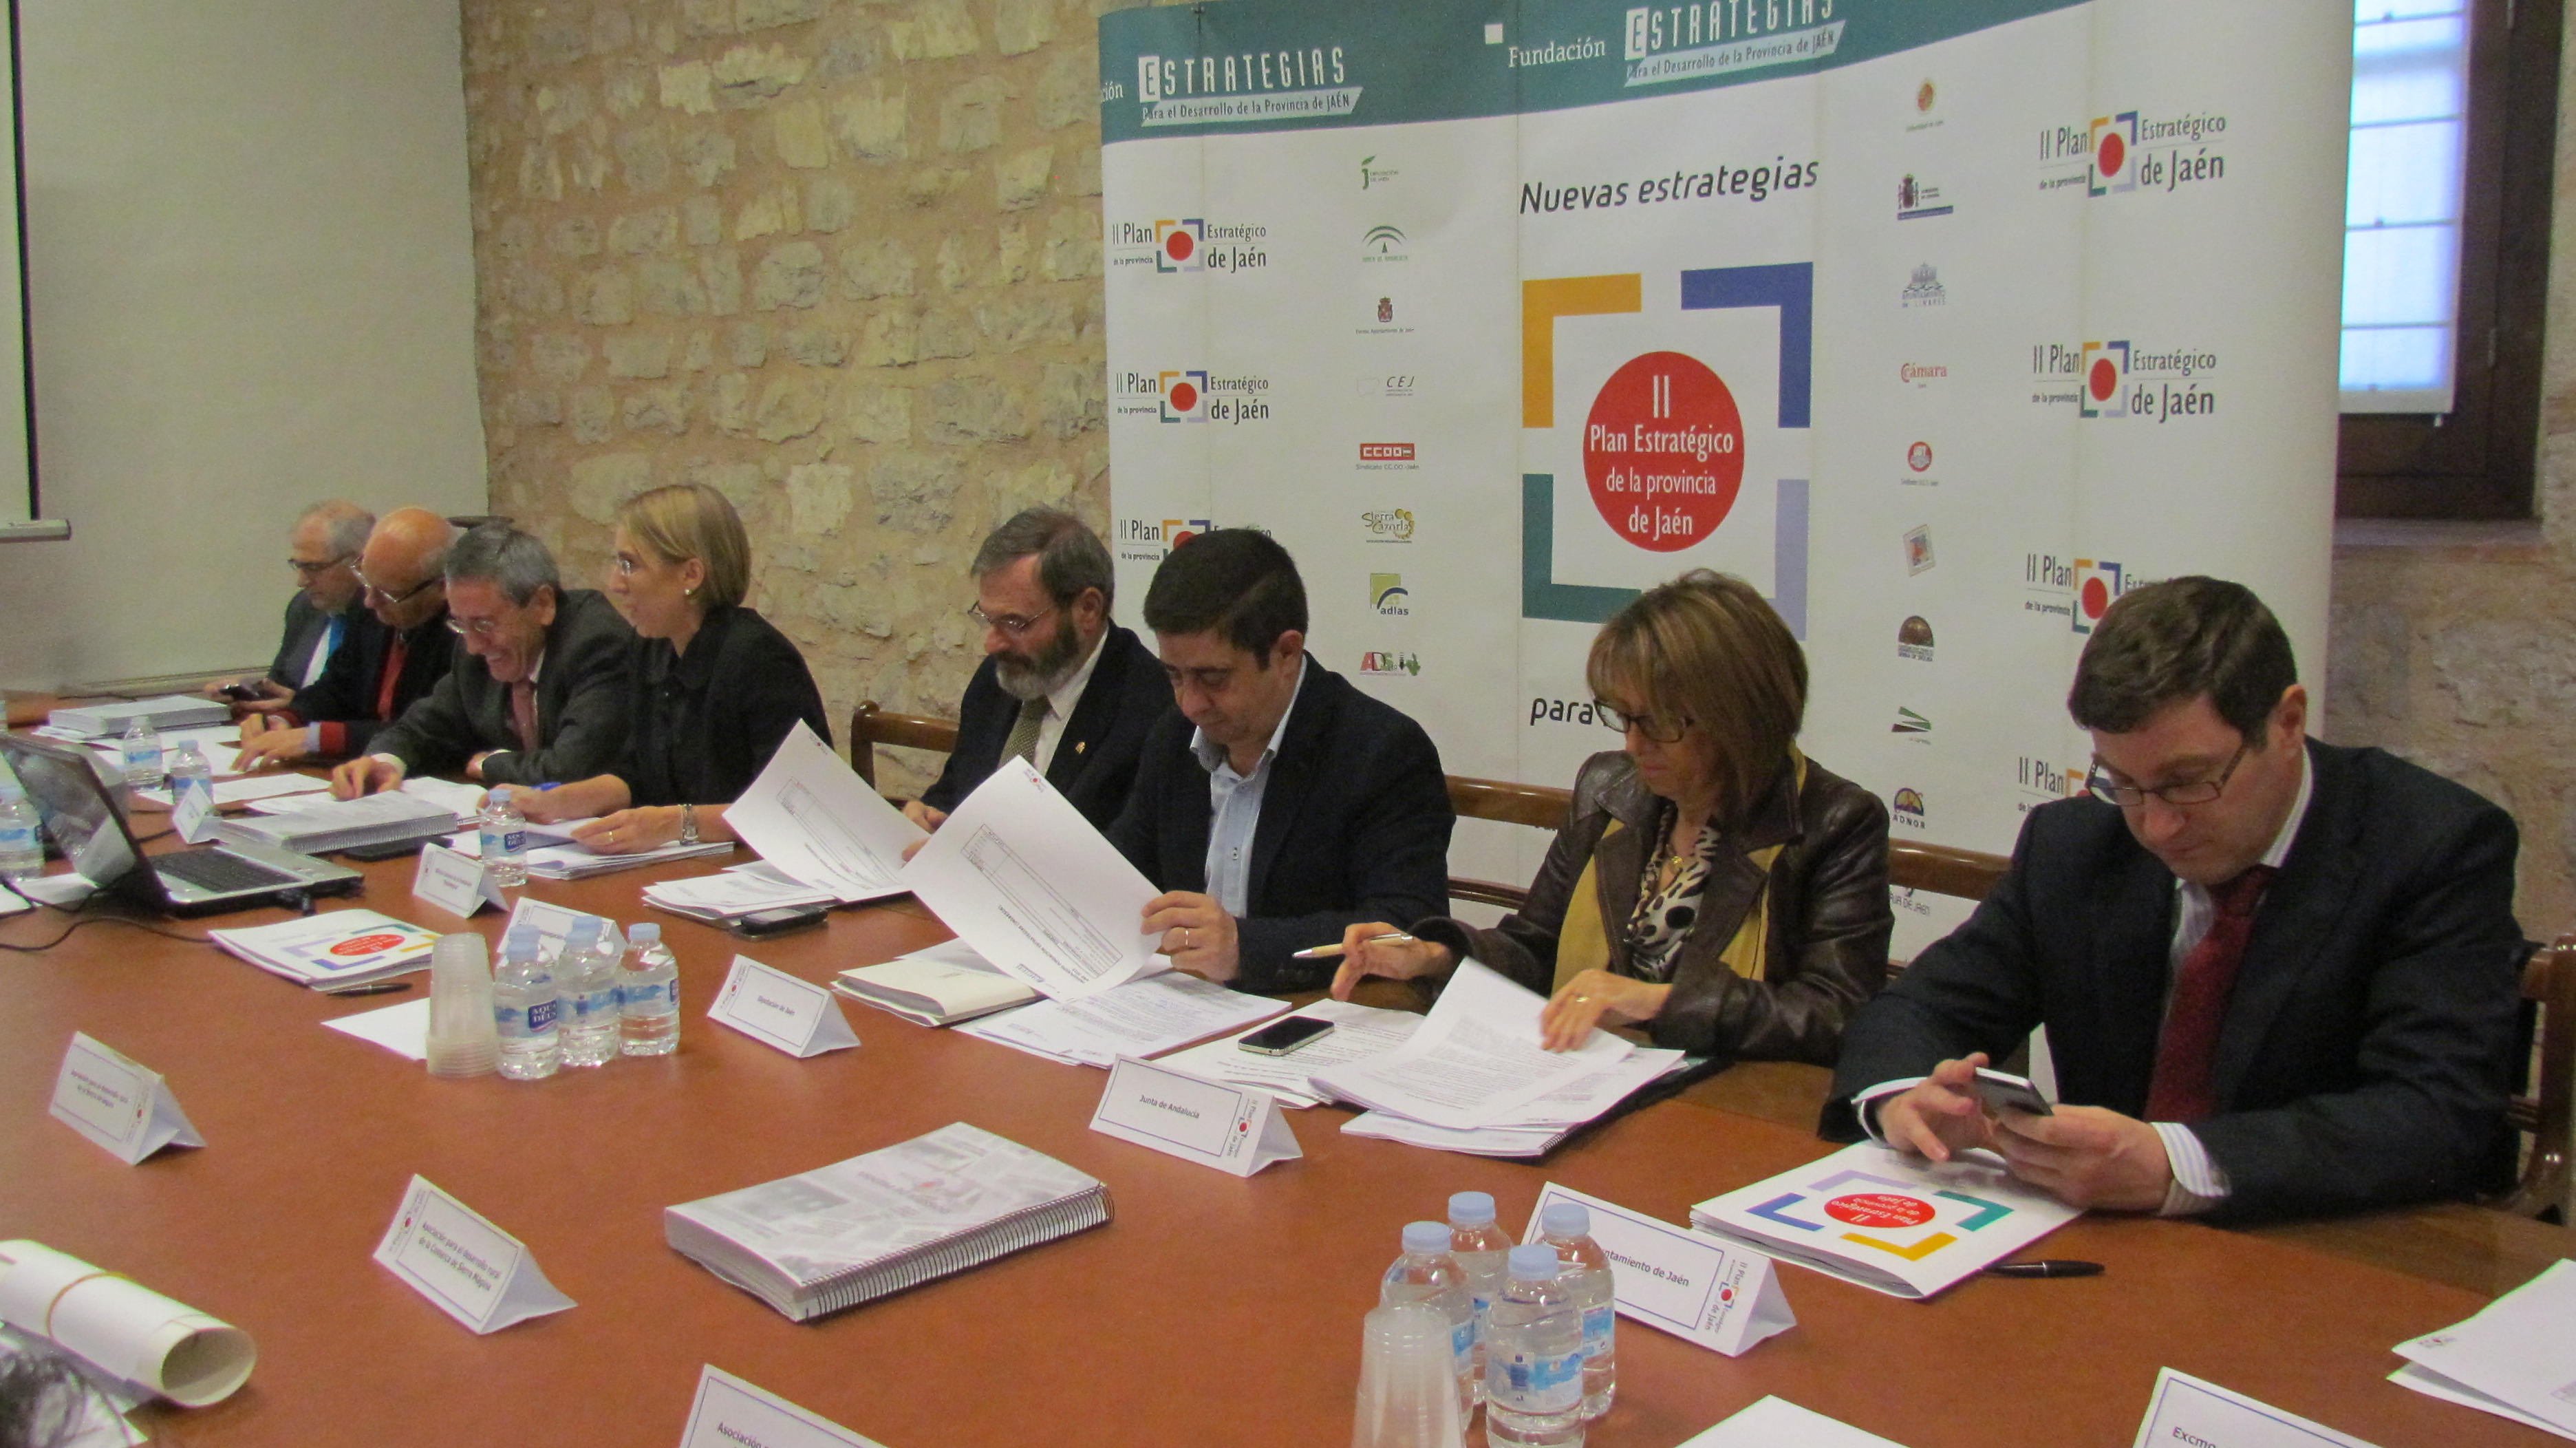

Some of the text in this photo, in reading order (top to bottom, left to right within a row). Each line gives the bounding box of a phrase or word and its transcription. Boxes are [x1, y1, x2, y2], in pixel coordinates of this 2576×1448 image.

[1508, 36, 1605, 67] Fundación
[1627, 63, 1648, 78] Para
[1652, 63, 1660, 76] el
[1664, 54, 1715, 74] Desarrollo
[1719, 52, 1729, 66] de
[1733, 48, 1742, 63] la
[1746, 42, 1792, 61] Provincia
[1796, 39, 1809, 52] de
[1139, 47, 1345, 102] ESTRATEGIAS
[1143, 92, 1350, 120] Para el Desarrollo de la Provincia de JAÉN
[2040, 112, 2226, 160] II Plan Estratégico
[2141, 147, 2225, 193] de Jaén
[1520, 156, 1819, 215] Nuevas estrategias
[1113, 224, 1266, 244] II Plan Estratégico
[1208, 246, 1266, 273] de Jaén
[1900, 363, 1947, 383] Cámara
[2033, 344, 2217, 376] II Plan Estratégico
[1116, 372, 1269, 394] II Plan Estratégico
[1653, 375, 1670, 418] II
[1212, 398, 1269, 425] de Jaén
[2132, 384, 2214, 423] de Jaén
[1590, 425, 1733, 462] Plan Estratégico
[1607, 467, 1716, 500] de la provincia
[1132, 520, 1159, 540] Plan
[1362, 511, 1394, 527] Sierra
[1373, 520, 1408, 534] Cazorla
[1629, 506, 1693, 541] de Jaén
[2043, 555, 2072, 587] Plan
[1381, 606, 1409, 615] adlas
[1530, 698, 1593, 726] para
[2035, 760, 2064, 795] Plan
[1893, 814, 1925, 829] ADNOR
[1139, 1094, 1200, 1119] Junta de Andalucía
[1893, 1215, 1918, 1224] Plan
[1653, 1267, 1665, 1278] de
[1666, 1271, 1689, 1286] Jaén
[1732, 1268, 1744, 1286] Plan
[1703, 1313, 1716, 1331] Jaén
[718, 1422, 762, 1448] Asociación
